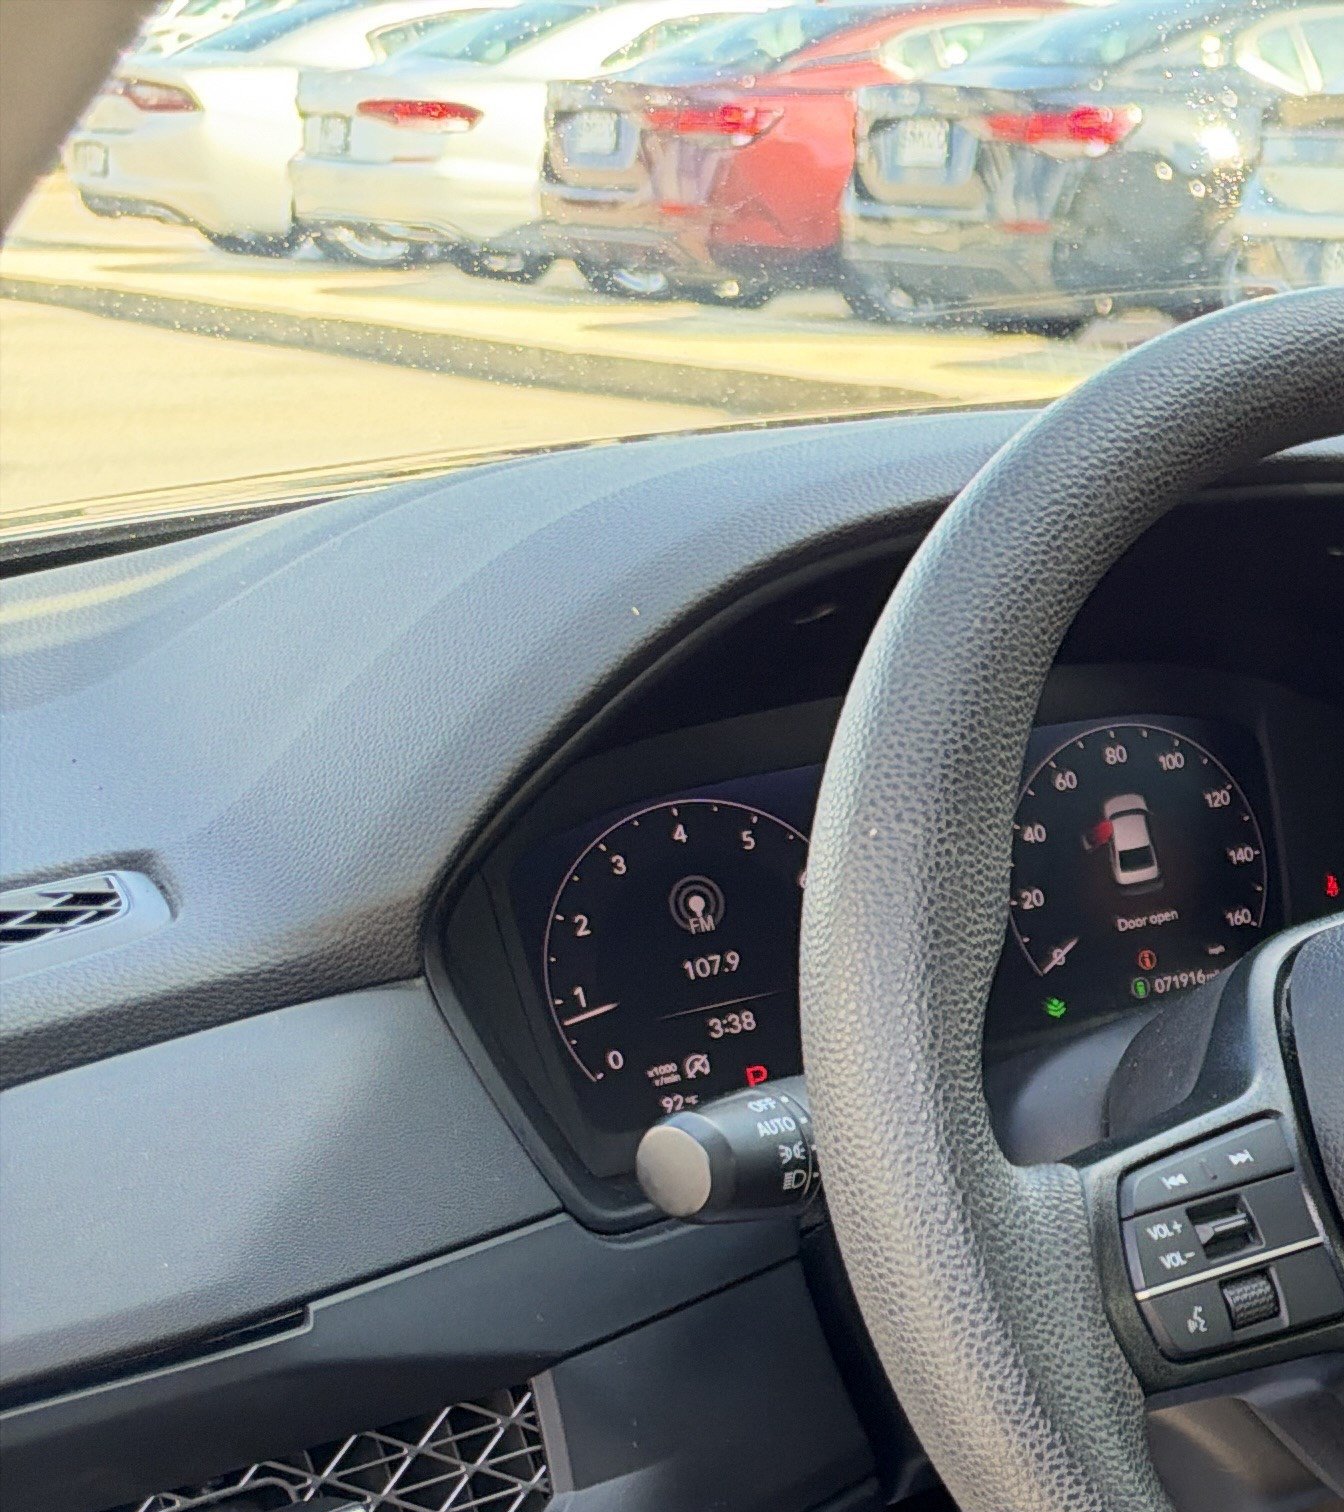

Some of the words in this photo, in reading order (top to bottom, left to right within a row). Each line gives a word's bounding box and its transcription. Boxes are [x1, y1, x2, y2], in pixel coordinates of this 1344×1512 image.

[1104, 744, 1128, 766] 80
[1158, 751, 1185, 772] 100
[1053, 771, 1078, 792] 60
[1204, 788, 1231, 809] 120
[671, 823, 688, 844] 4
[741, 830, 757, 851] 5
[1022, 824, 1047, 844] 40
[610, 854, 627, 876] 3
[1228, 846, 1255, 866] 140
[1020, 888, 1045, 911] 20
[573, 914, 592, 937] 2
[688, 913, 717, 935] FM
[1116, 915, 1150, 933] Door
[1149, 908, 1180, 928] open
[1223, 907, 1252, 928] 160
[682, 950, 740, 981] 107.9
[1153, 968, 1206, 994] 071916
[573, 986, 587, 1008] 1
[708, 1010, 757, 1039] 3:38
[606, 1050, 625, 1071] 0
[745, 1064, 768, 1087] P
[747, 1096, 777, 1114] OFF
[756, 1116, 797, 1139] AUTO
